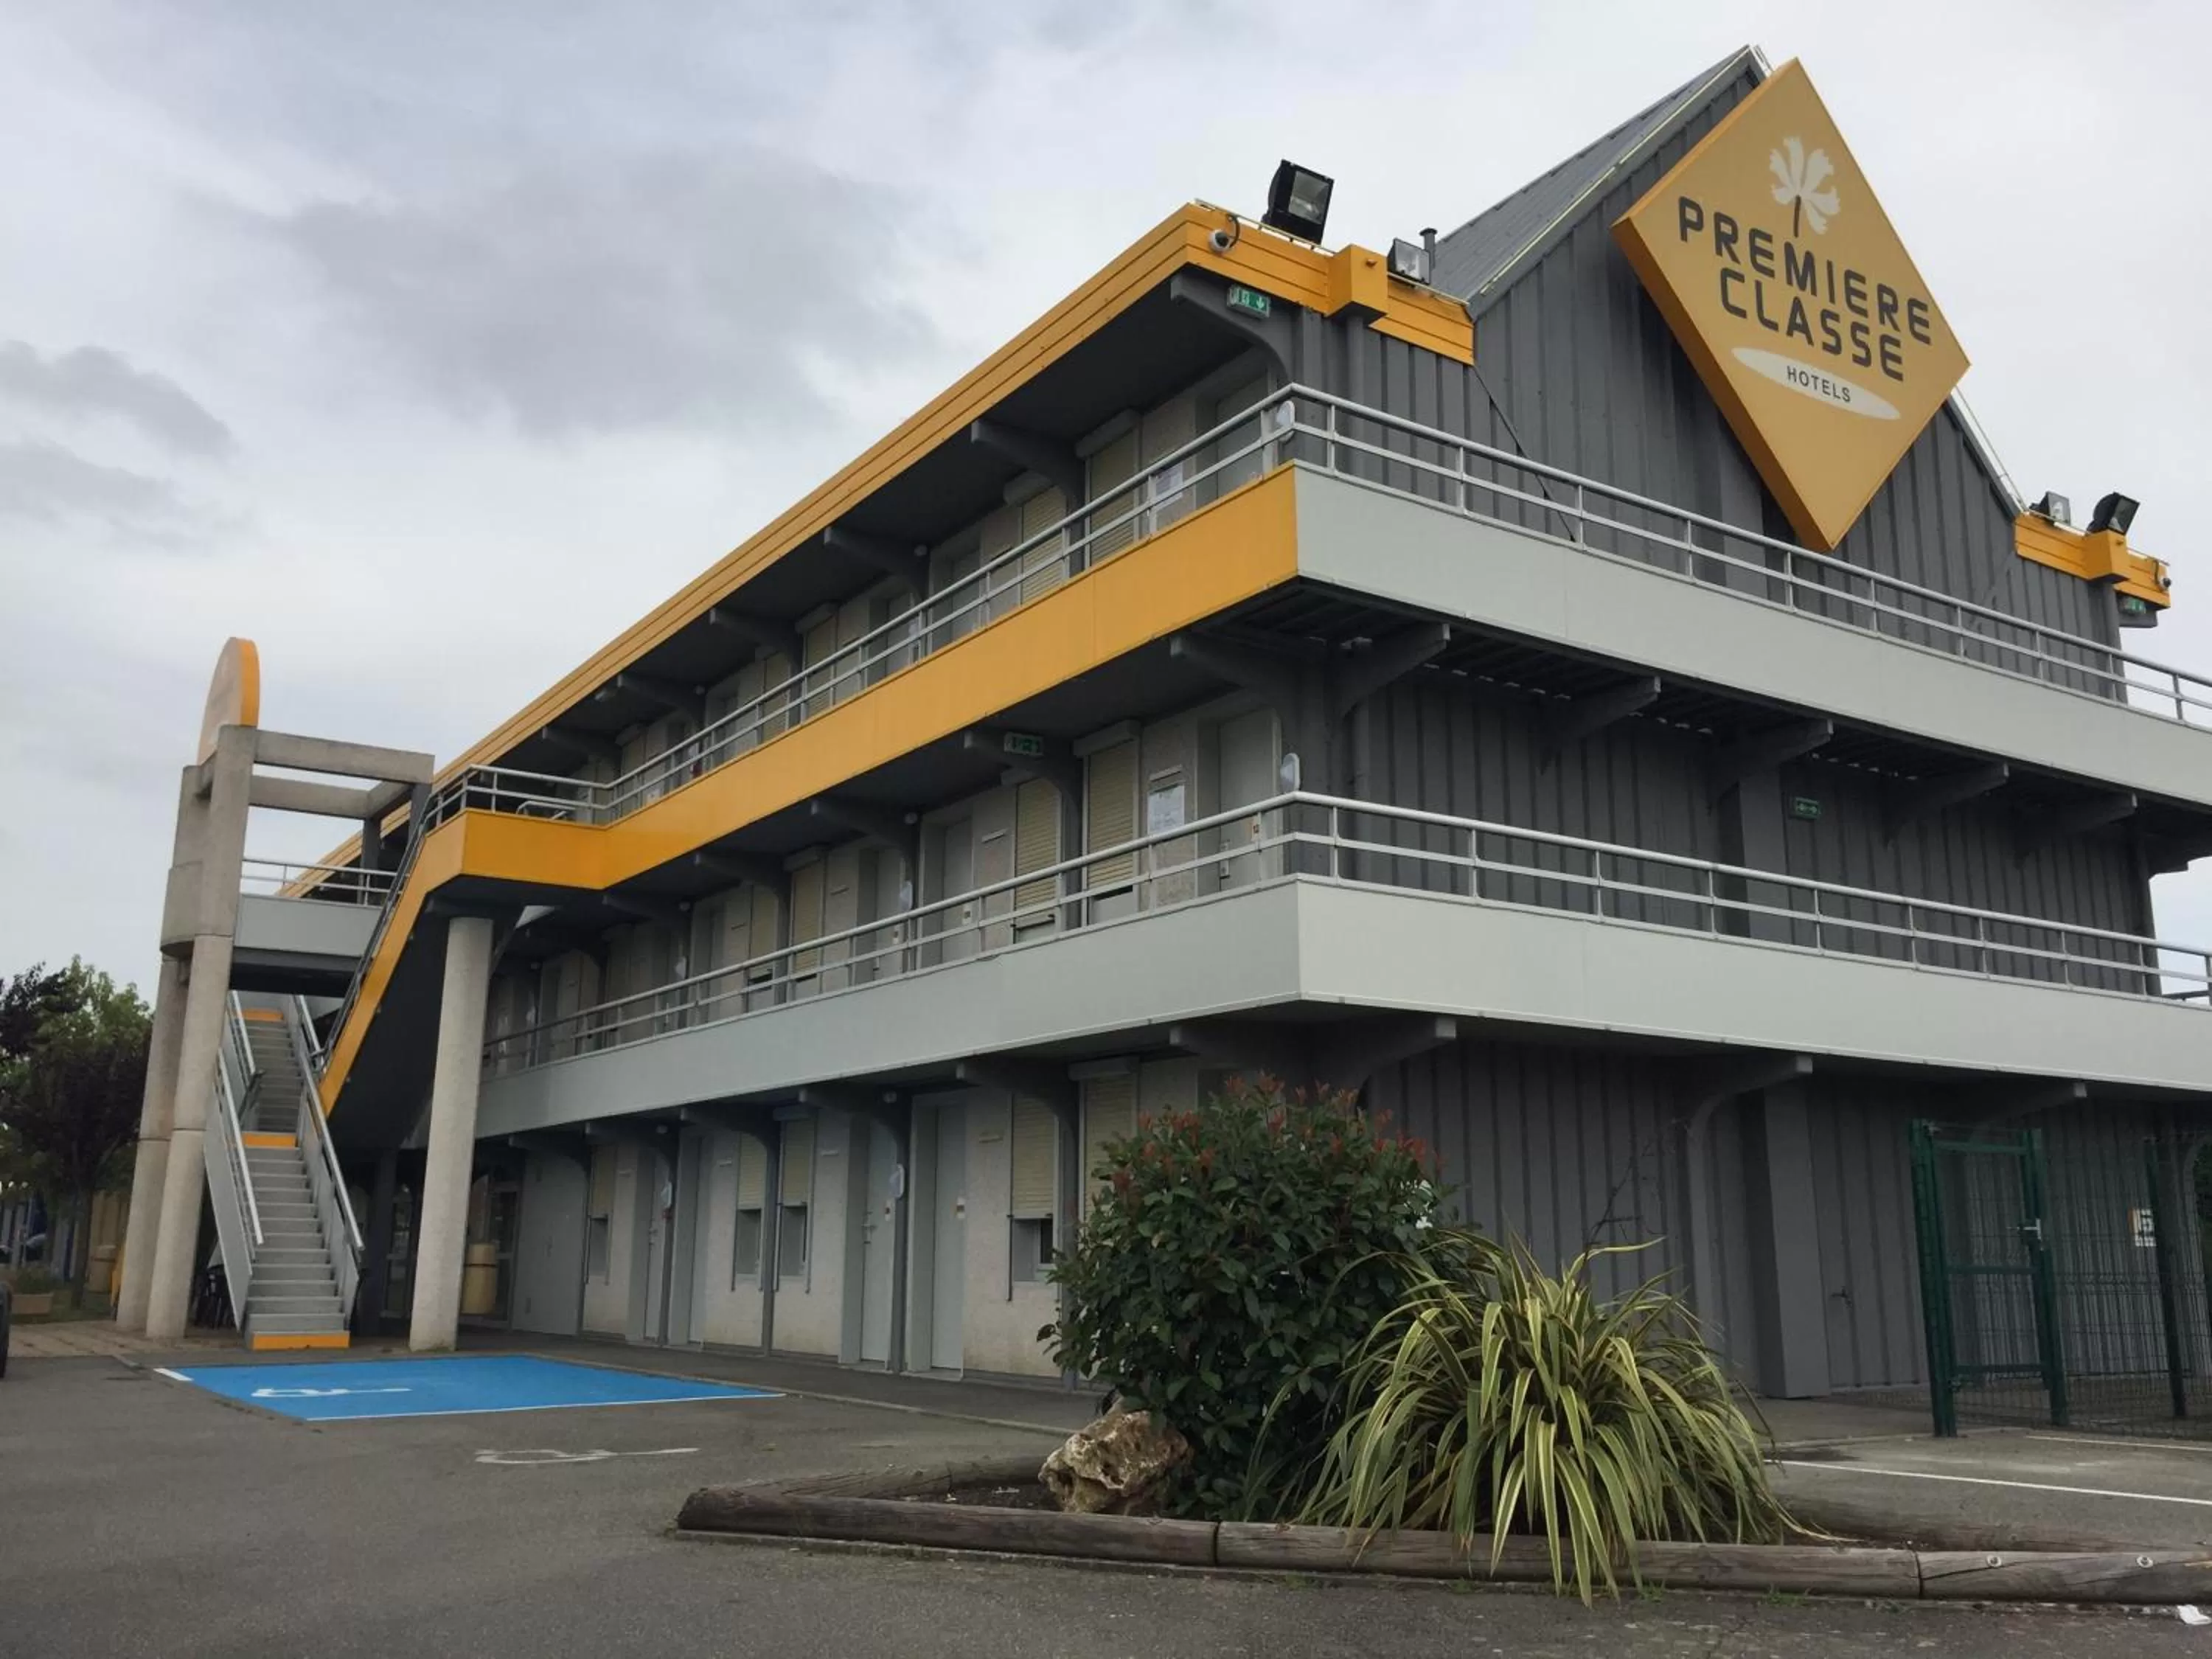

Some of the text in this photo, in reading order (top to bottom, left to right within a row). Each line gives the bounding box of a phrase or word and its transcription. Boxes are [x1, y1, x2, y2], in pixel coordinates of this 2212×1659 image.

[1679, 197, 1931, 344] PREMIERE
[1720, 268, 1904, 381] CLASSE
[1787, 366, 1851, 403] HOTELS
